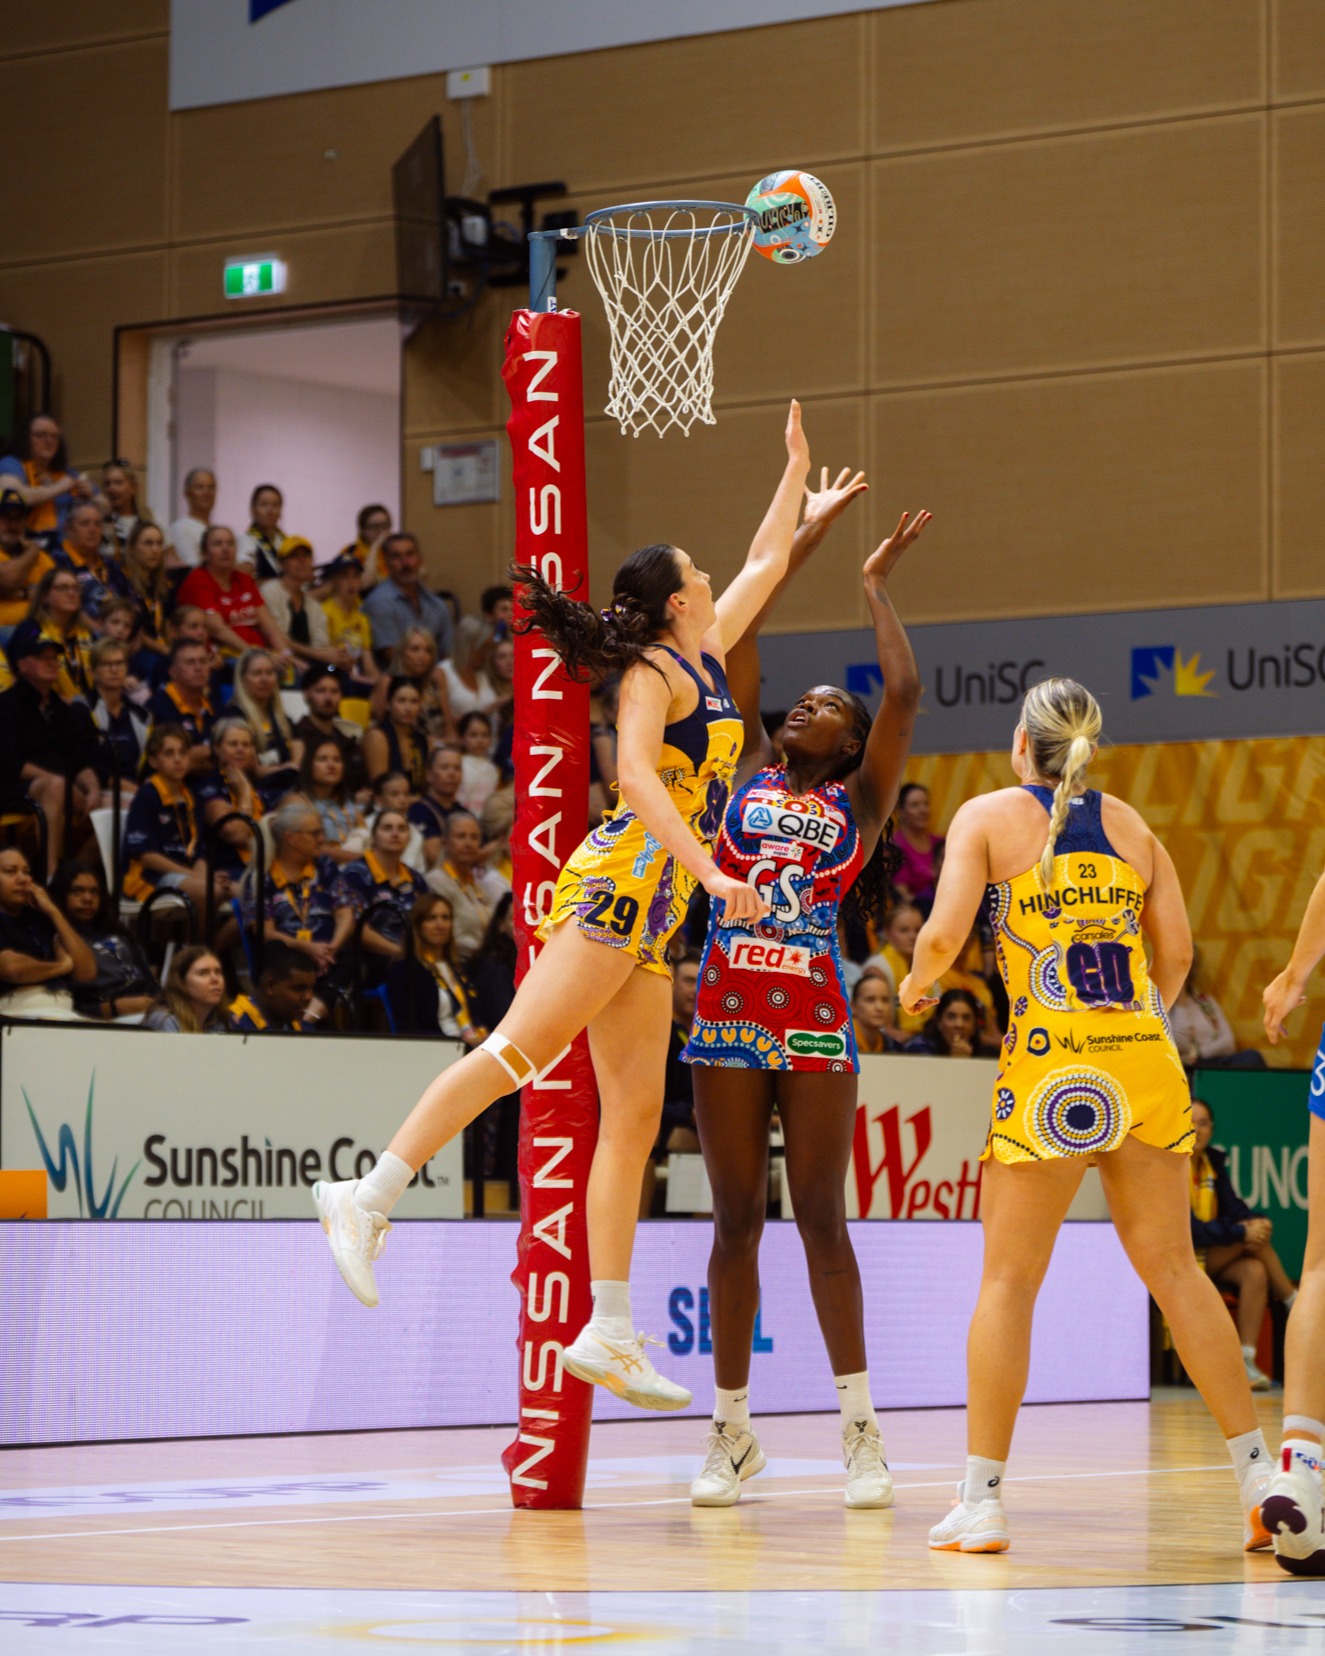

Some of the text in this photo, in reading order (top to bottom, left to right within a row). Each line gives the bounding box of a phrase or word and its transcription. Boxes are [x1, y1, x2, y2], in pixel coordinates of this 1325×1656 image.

[777, 814, 836, 848] QBE
[761, 842, 790, 852] aware
[1078, 863, 1097, 879] 23
[746, 859, 804, 923] GS
[1019, 886, 1142, 916] HINCHLIFFE
[583, 890, 639, 937] 29
[1074, 931, 1115, 941] carsales
[733, 943, 785, 968] red
[781, 963, 806, 975] energy
[1066, 942, 1132, 1004] GD
[791, 1037, 841, 1050] Specsavers
[1086, 1032, 1161, 1045] Sunshine Coast
[1088, 1045, 1123, 1053] COUNCIL
[143, 1134, 322, 1189] Sunshine
[511, 1137, 575, 1490] NISSAN
